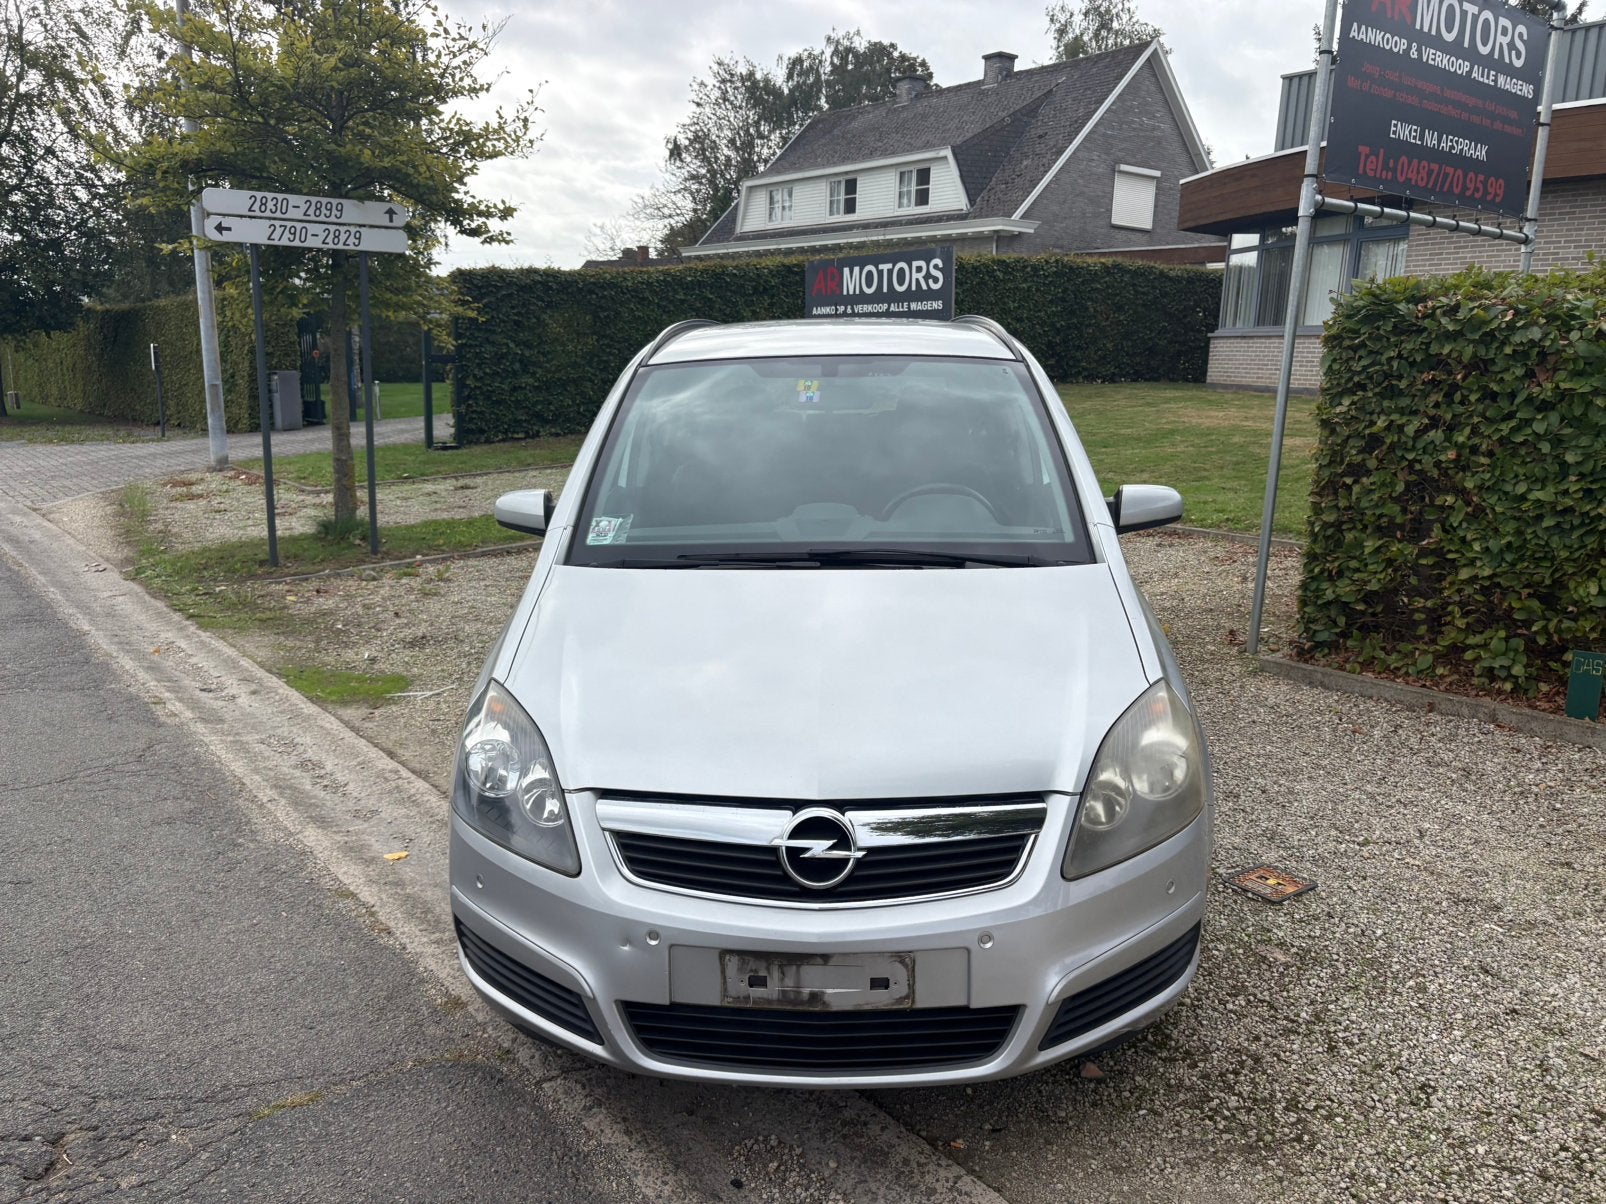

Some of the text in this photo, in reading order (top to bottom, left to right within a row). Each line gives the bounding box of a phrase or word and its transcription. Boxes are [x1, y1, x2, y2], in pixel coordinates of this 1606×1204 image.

[1415, 0, 1528, 68] MOTORS
[1349, 22, 1408, 54] AANKOOP
[1409, 42, 1418, 59] &
[1422, 45, 1470, 76] VERKOOP
[1471, 64, 1495, 86] ALLE
[1496, 72, 1534, 99] WAGENS
[1389, 120, 1488, 161] ENKEL NA AFSPRAAK
[1358, 145, 1505, 203] Tel.: 0487/70 95 99
[247, 194, 344, 219] 2830-2899
[267, 223, 362, 247] 2790-2829
[812, 258, 944, 297] AR MOTORS
[846, 304, 852, 314] &
[853, 303, 888, 314] VERKOOP
[889, 302, 908, 312] ALLE
[910, 300, 943, 311] WAGENS
